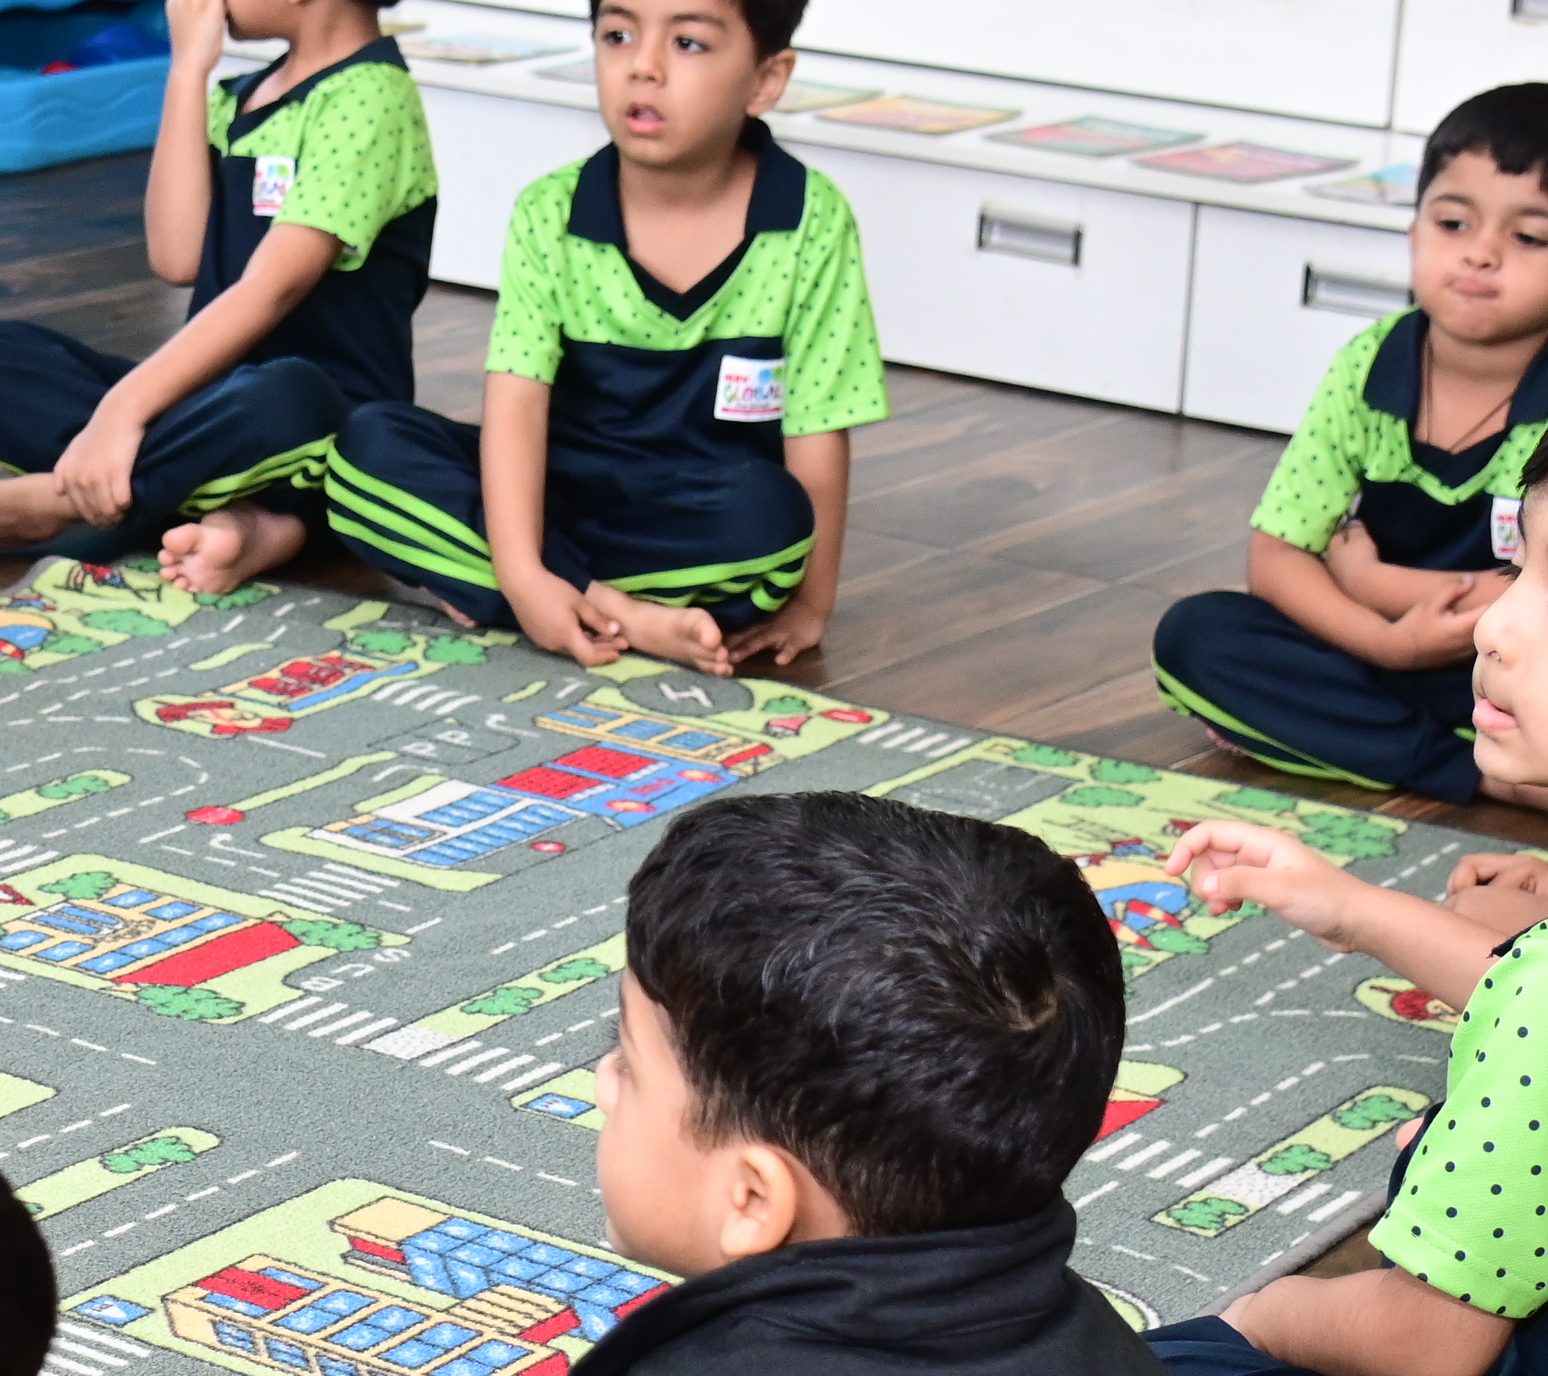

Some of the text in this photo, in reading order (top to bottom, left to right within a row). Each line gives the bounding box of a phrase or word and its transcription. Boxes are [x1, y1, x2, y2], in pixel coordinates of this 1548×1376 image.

[435, 728, 471, 747] P
[403, 738, 437, 758] P
[300, 947, 412, 993] BUS
